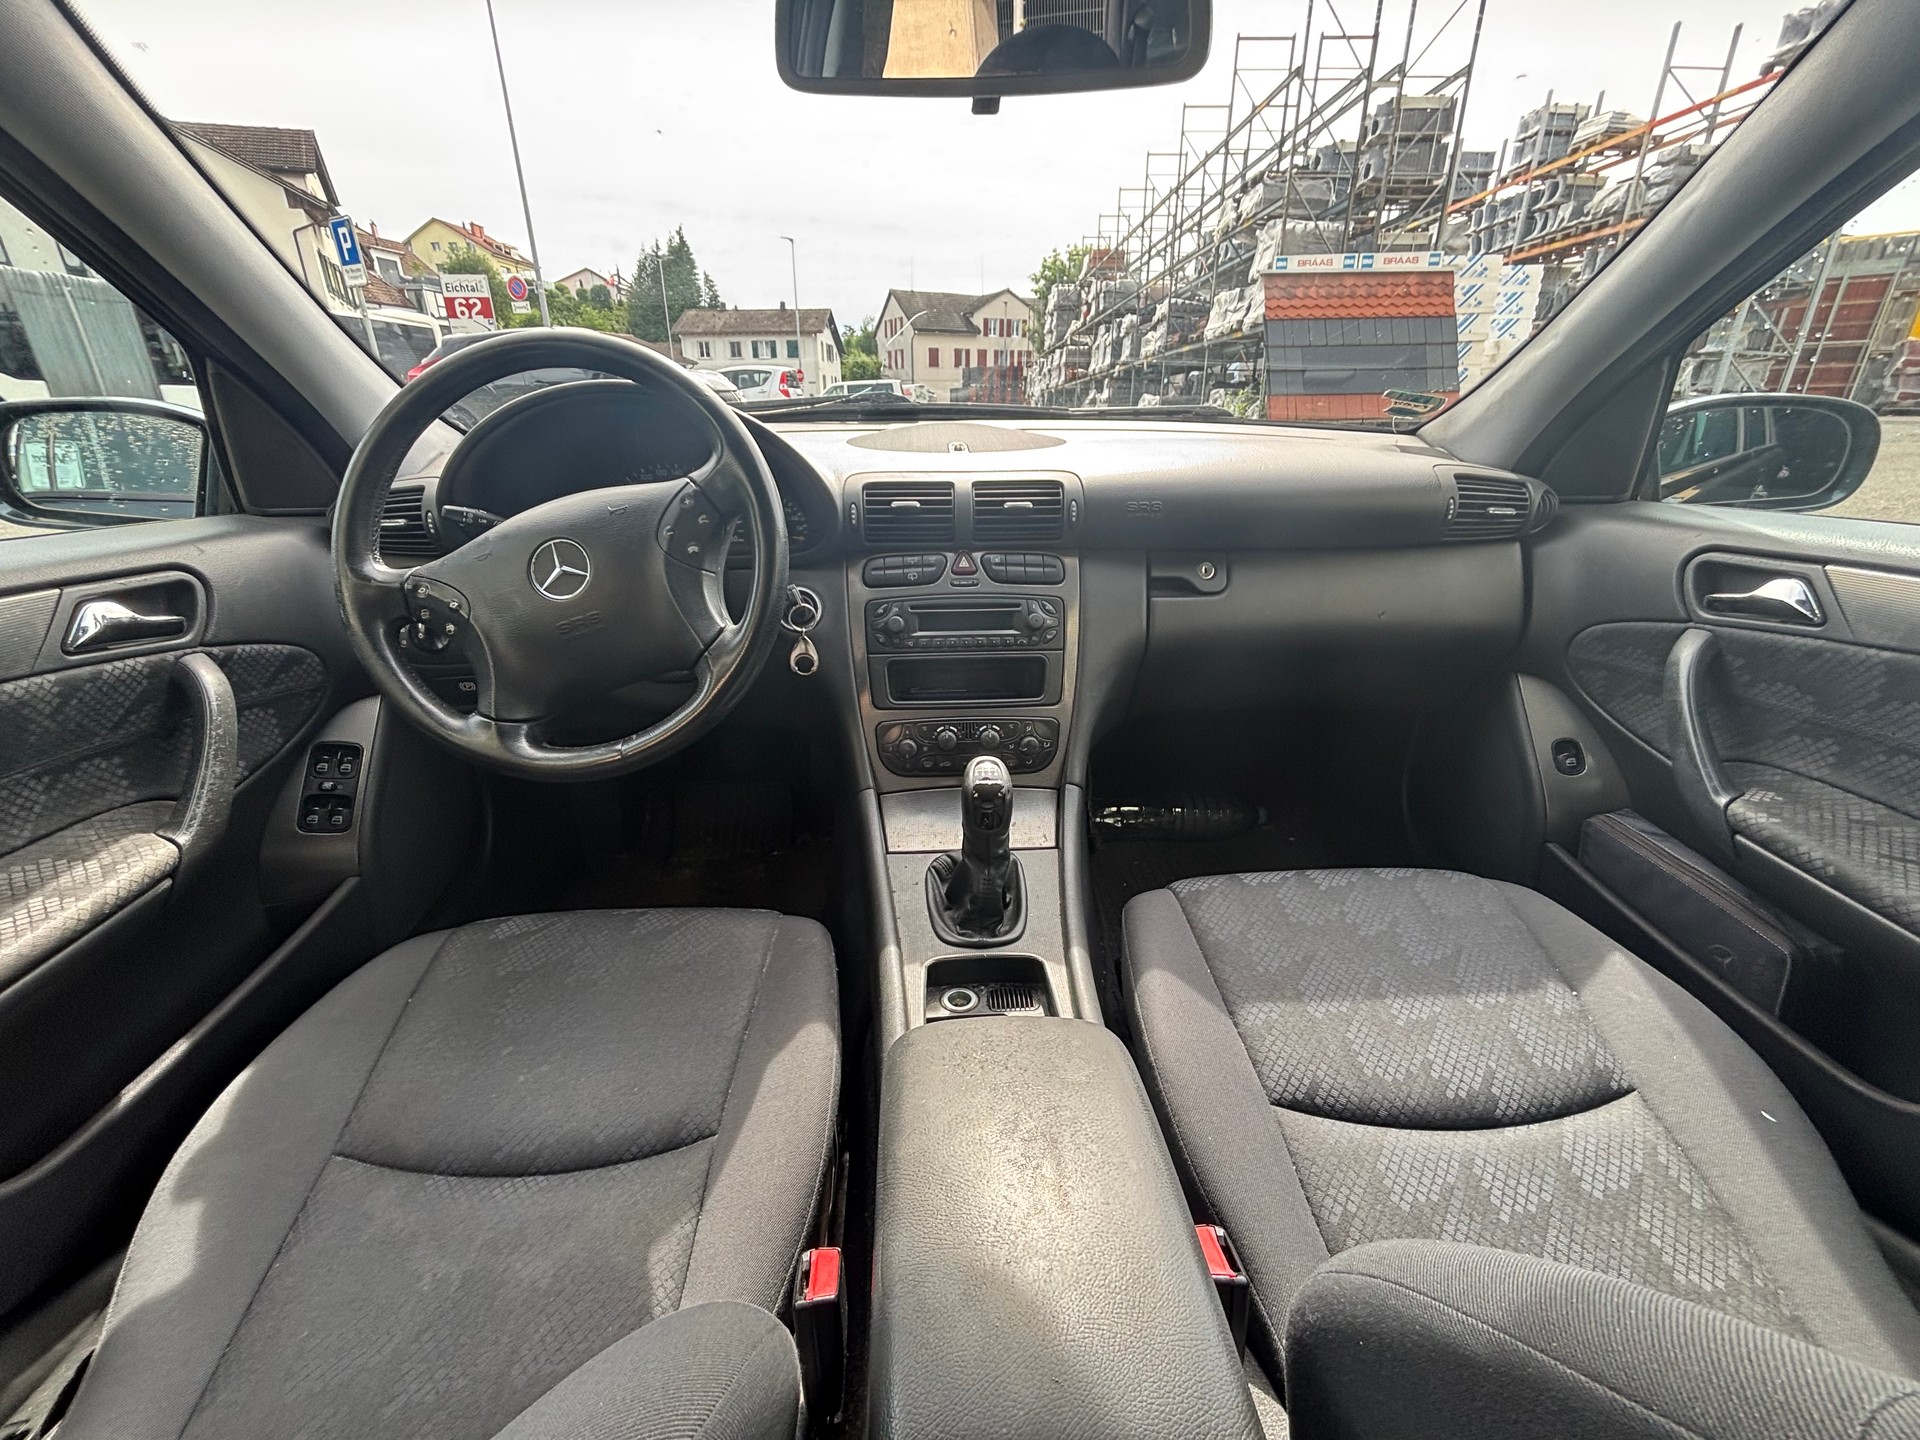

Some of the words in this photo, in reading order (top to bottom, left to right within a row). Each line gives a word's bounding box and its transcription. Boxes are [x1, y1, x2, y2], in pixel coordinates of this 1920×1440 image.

[337, 226, 352, 261] P
[445, 281, 480, 293] Eichtal
[454, 298, 484, 320] 62
[1126, 501, 1163, 511] SRS
